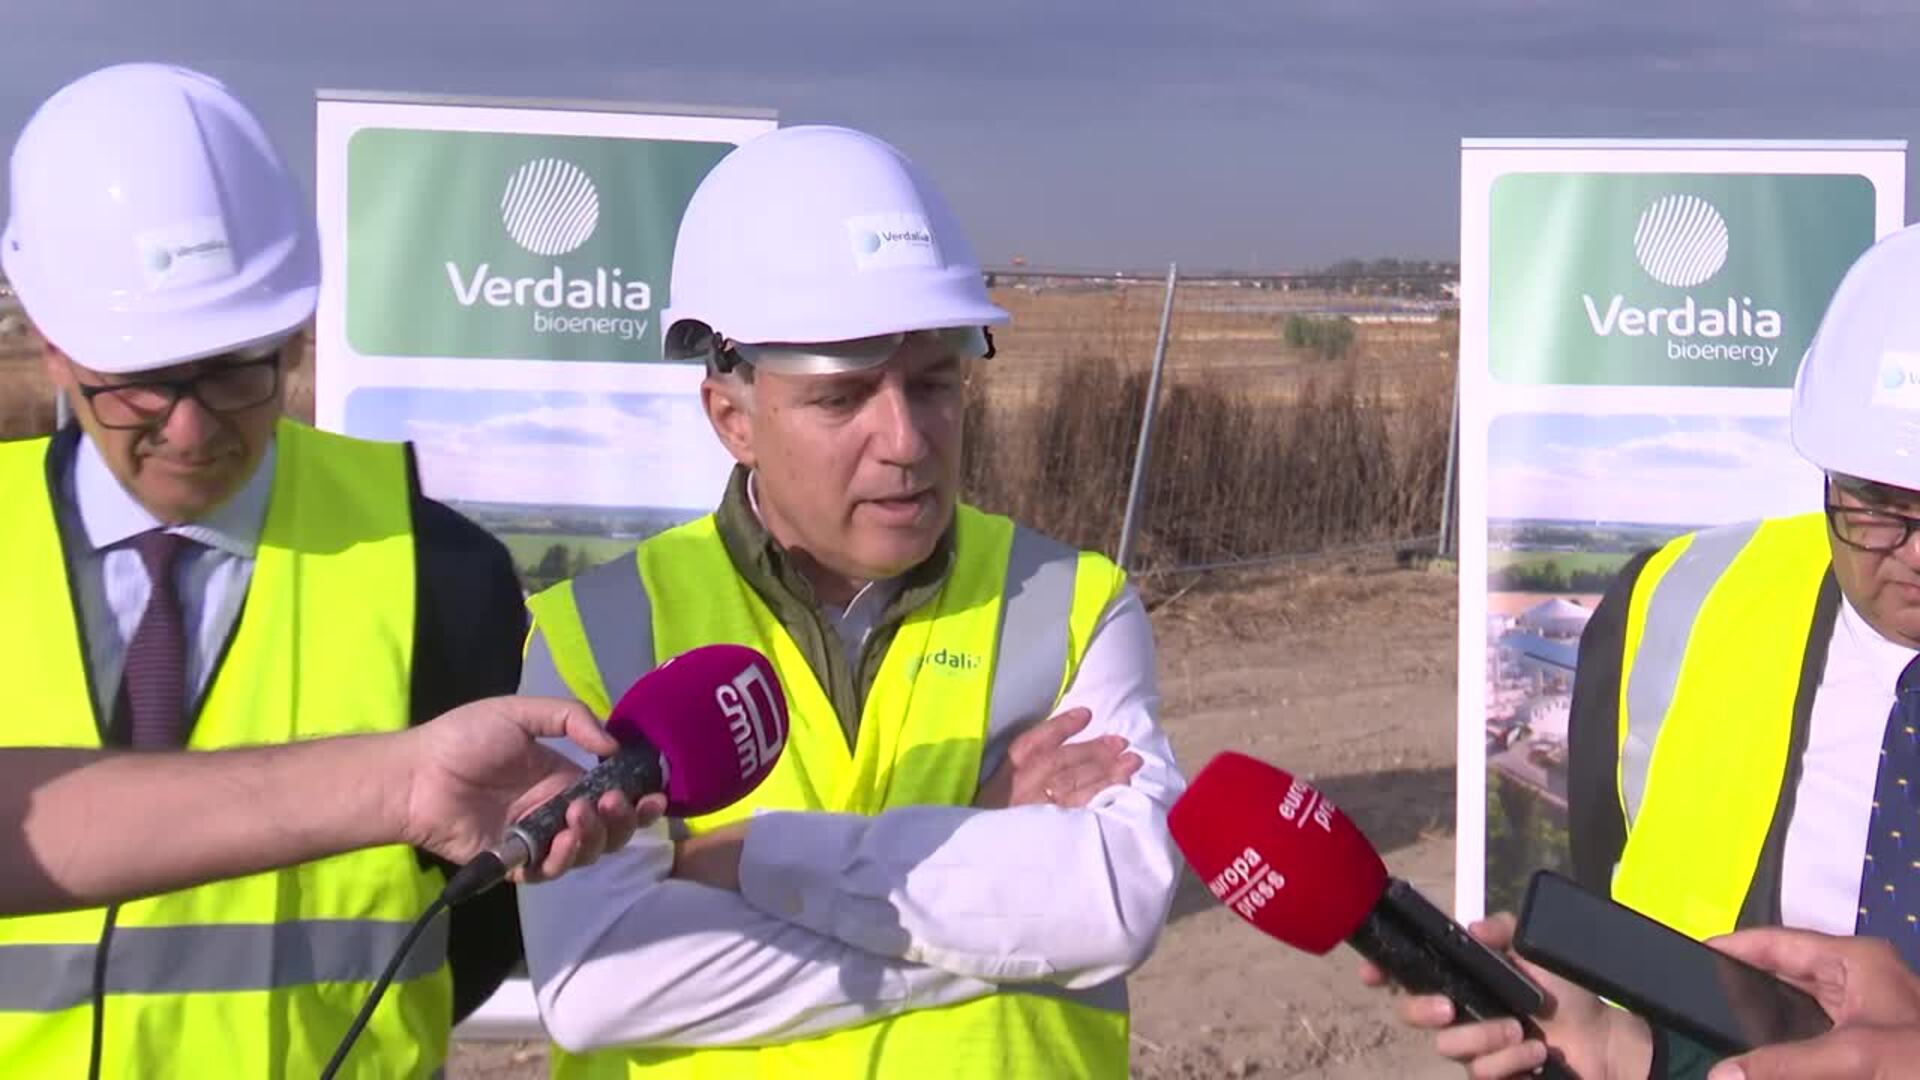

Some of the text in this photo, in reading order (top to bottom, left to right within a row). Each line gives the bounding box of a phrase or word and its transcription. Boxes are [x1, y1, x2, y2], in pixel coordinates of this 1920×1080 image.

[445, 261, 652, 311] Verdalia
[533, 311, 648, 340] bioenergy
[1582, 294, 1782, 338] Verdalia
[1667, 339, 1779, 366] bioenergy
[715, 683, 759, 779] cmm
[1236, 870, 1286, 920] press
